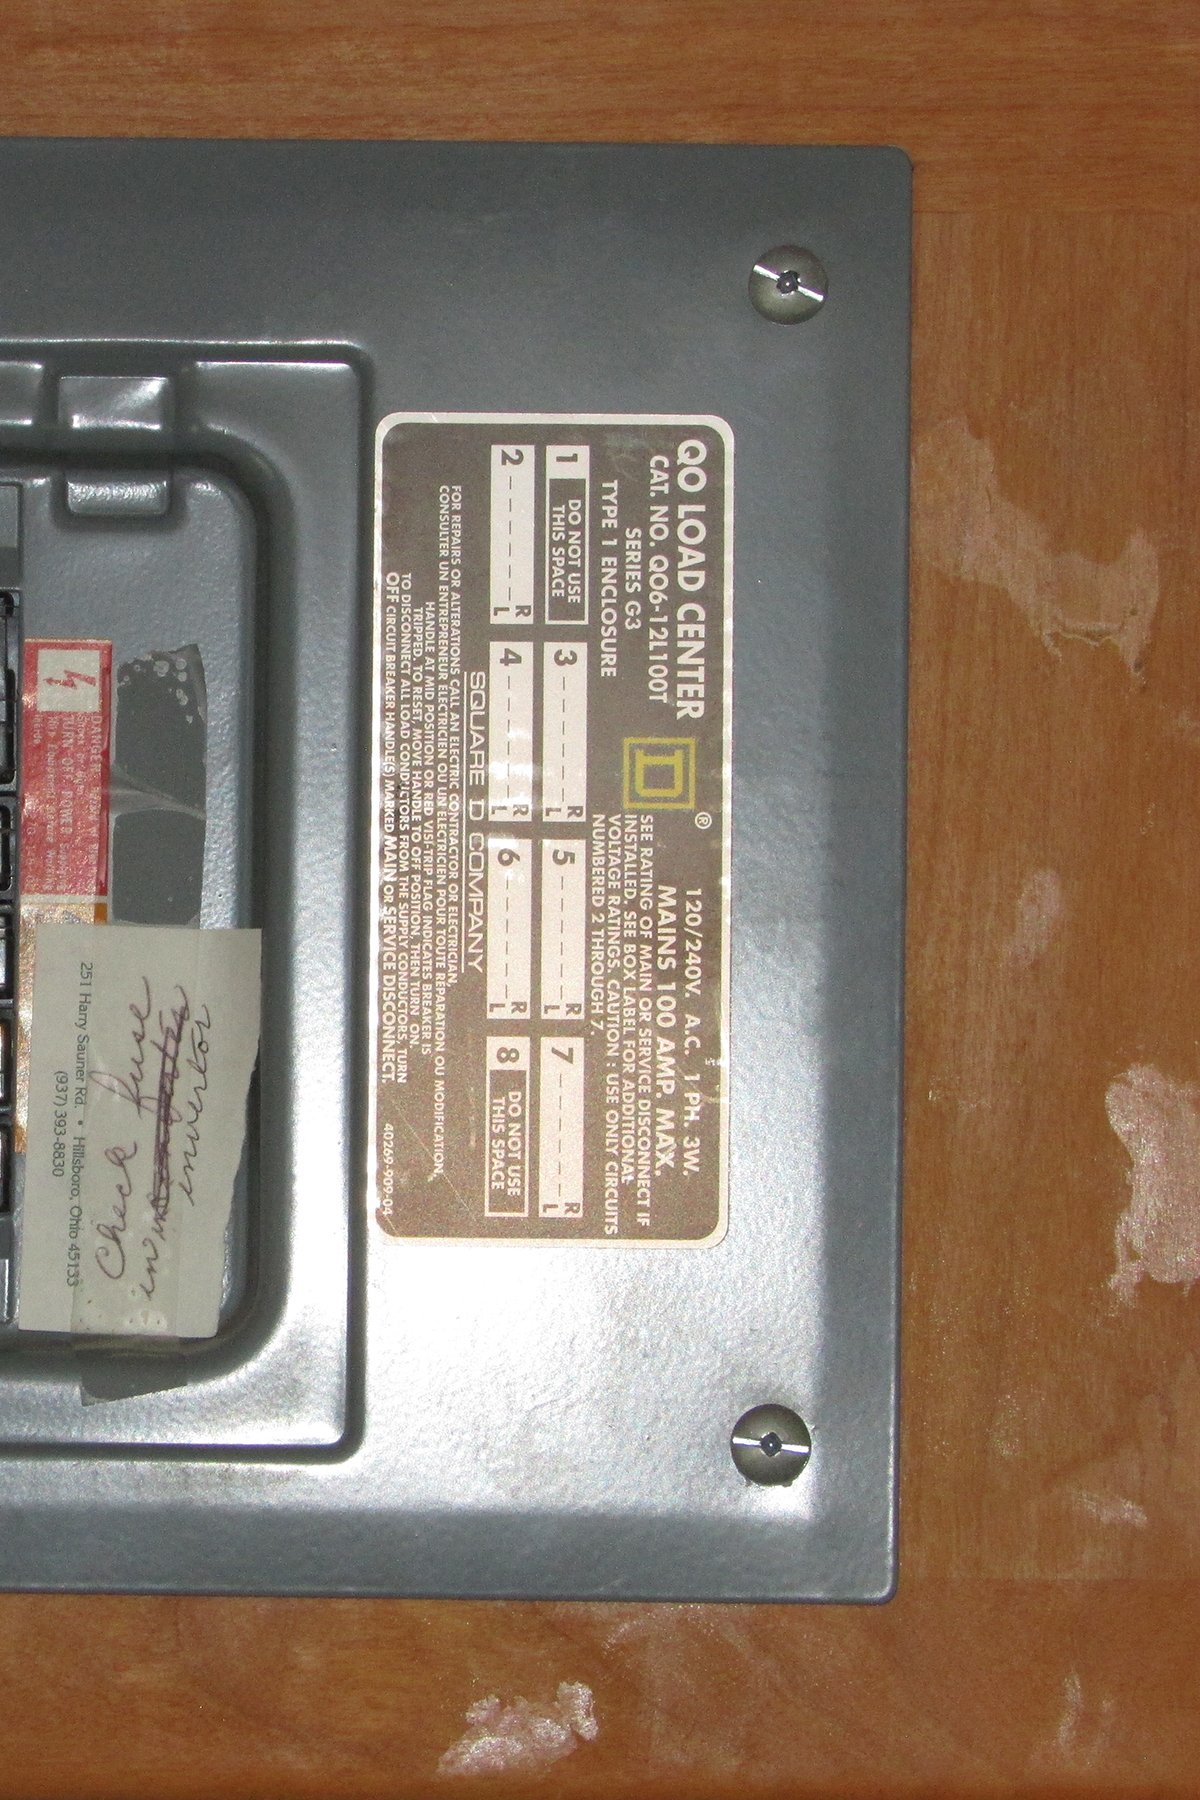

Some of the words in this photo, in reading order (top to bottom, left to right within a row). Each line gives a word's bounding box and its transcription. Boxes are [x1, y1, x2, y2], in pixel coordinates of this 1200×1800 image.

[501, 449, 524, 466] 2
[556, 453, 578, 463] 1
[648, 455, 669, 497] CAT.
[676, 439, 707, 492] QO
[450, 485, 462, 510] FOR
[567, 499, 581, 525] DO
[601, 480, 618, 528] TYPE
[450, 515, 462, 565] REPAIRS
[551, 505, 565, 541] THIS
[601, 538, 618, 546] 1
[648, 505, 669, 547] NO.
[567, 531, 581, 567] NOT
[624, 528, 642, 593] SERIES
[676, 504, 707, 592] LOAD
[449, 569, 461, 587] OR
[551, 547, 565, 597] SPACE
[567, 573, 581, 603] USE
[449, 591, 461, 675] ALTERATIONS
[600, 557, 618, 677] ENCLOSURE
[624, 600, 642, 630] G3
[648, 555, 669, 703] QO6-12L100T
[499, 648, 522, 666] 4
[554, 649, 577, 667] 3
[676, 603, 706, 720] CENTER
[448, 679, 460, 708] CALL
[448, 712, 460, 732] AN
[468, 672, 485, 786] SQUARE
[448, 736, 460, 789] ELECTRIC
[468, 798, 485, 821] D
[640, 815, 653, 841] SEE
[447, 793, 460, 879] CONTRACTOR
[607, 814, 621, 889] VOLTAGE
[498, 848, 520, 867] 6
[552, 849, 576, 866] 5
[590, 814, 605, 907] NUMBERED
[623, 815, 637, 904] INSTALLED.
[447, 883, 459, 902] OR
[639, 848, 653, 910] RATING
[467, 832, 484, 973] COMPANY
[590, 913, 604, 923] 2
[606, 896, 621, 973] RATINGS.
[622, 911, 636, 937] SEE
[639, 916, 653, 939] OF
[656, 885, 676, 970] MAINS
[683, 887, 702, 998] 120/240V.
[446, 906, 459, 987] ELECTRICIAN,
[622, 944, 636, 981] BOX
[638, 944, 653, 991] MAIN
[79, 962, 94, 987] 251
[590, 929, 604, 1014] THROUGH
[75, 992, 91, 1030] Harry
[605, 979, 620, 1056] CAUTION
[622, 987, 635, 1035] LABEL
[638, 997, 652, 1022] OR
[656, 982, 676, 1028] 100
[88, 976, 161, 1119] fuse
[590, 1020, 604, 1035] 7.
[683, 1013, 701, 1056] A.C.
[75, 1034, 90, 1082] Sauner
[496, 1047, 520, 1064] 8
[551, 1047, 574, 1064] 7
[621, 1040, 635, 1073] FOR
[637, 1028, 652, 1093] SERVICE
[655, 1036, 676, 1098] AMP.
[52, 1070, 68, 1106] (937)
[74, 1087, 87, 1109] Rd.
[605, 1073, 619, 1103] USE
[683, 1073, 701, 1081] 1
[491, 1097, 505, 1133] THIS
[507, 1091, 521, 1117] DO
[682, 1091, 701, 1126] PH.
[52, 1110, 68, 1177] 393-8830
[506, 1123, 521, 1160] NOT
[604, 1110, 619, 1155] ONLY
[636, 1100, 651, 1207] DISCONNECT
[655, 1108, 675, 1176] MAX.
[69, 1136, 86, 1201] Hillsboro,
[382, 1122, 394, 1217] 40269-909-04
[491, 1139, 505, 1189] SPACE
[682, 1137, 701, 1177] 3W.
[506, 1165, 521, 1196] USE
[604, 1161, 619, 1234] CIRCUITS
[68, 1205, 83, 1239] Ohio
[95, 1140, 137, 1281] Check
[636, 1212, 651, 1226] IF
[66, 1243, 81, 1288] 45133
[139, 1238, 161, 1301] in
